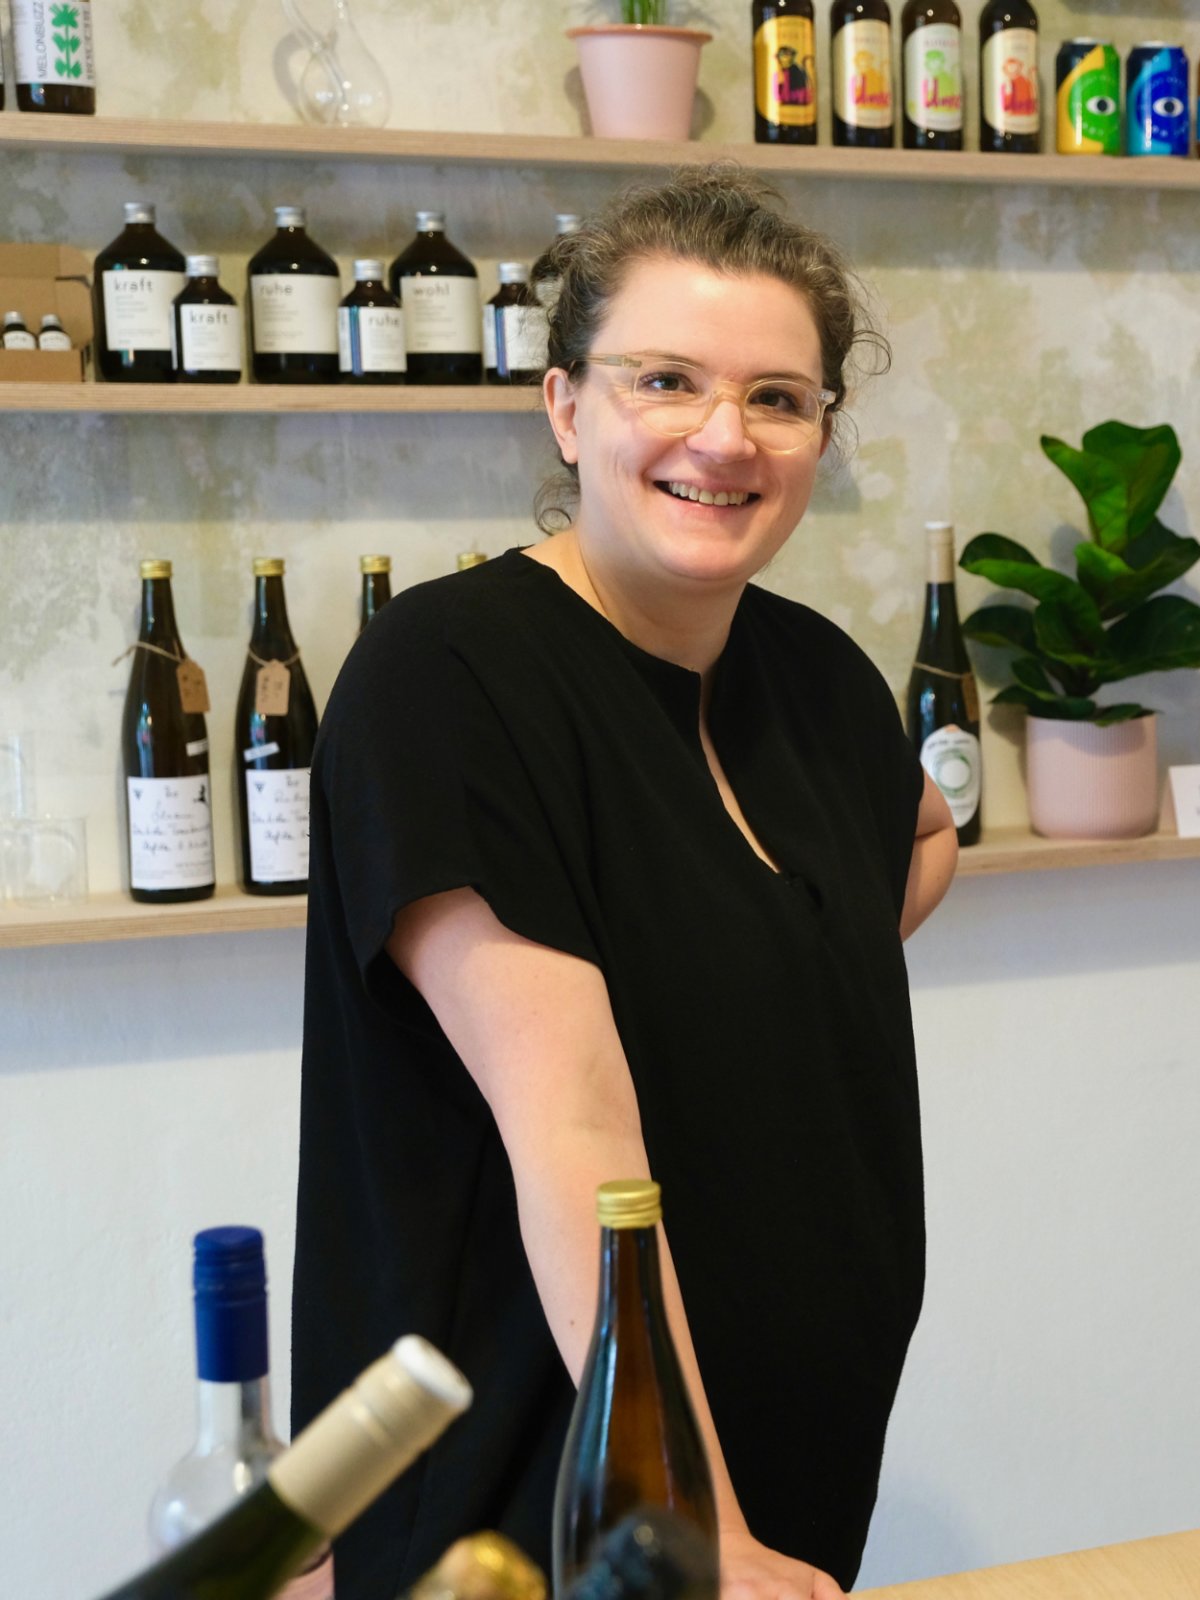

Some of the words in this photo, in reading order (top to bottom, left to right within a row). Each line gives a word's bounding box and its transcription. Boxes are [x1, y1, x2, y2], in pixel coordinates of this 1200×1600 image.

[114, 276, 153, 291] kraft
[259, 282, 293, 296] ruhe
[412, 284, 450, 296] wohl
[190, 309, 228, 323] kraft
[368, 313, 399, 327] ruhe
